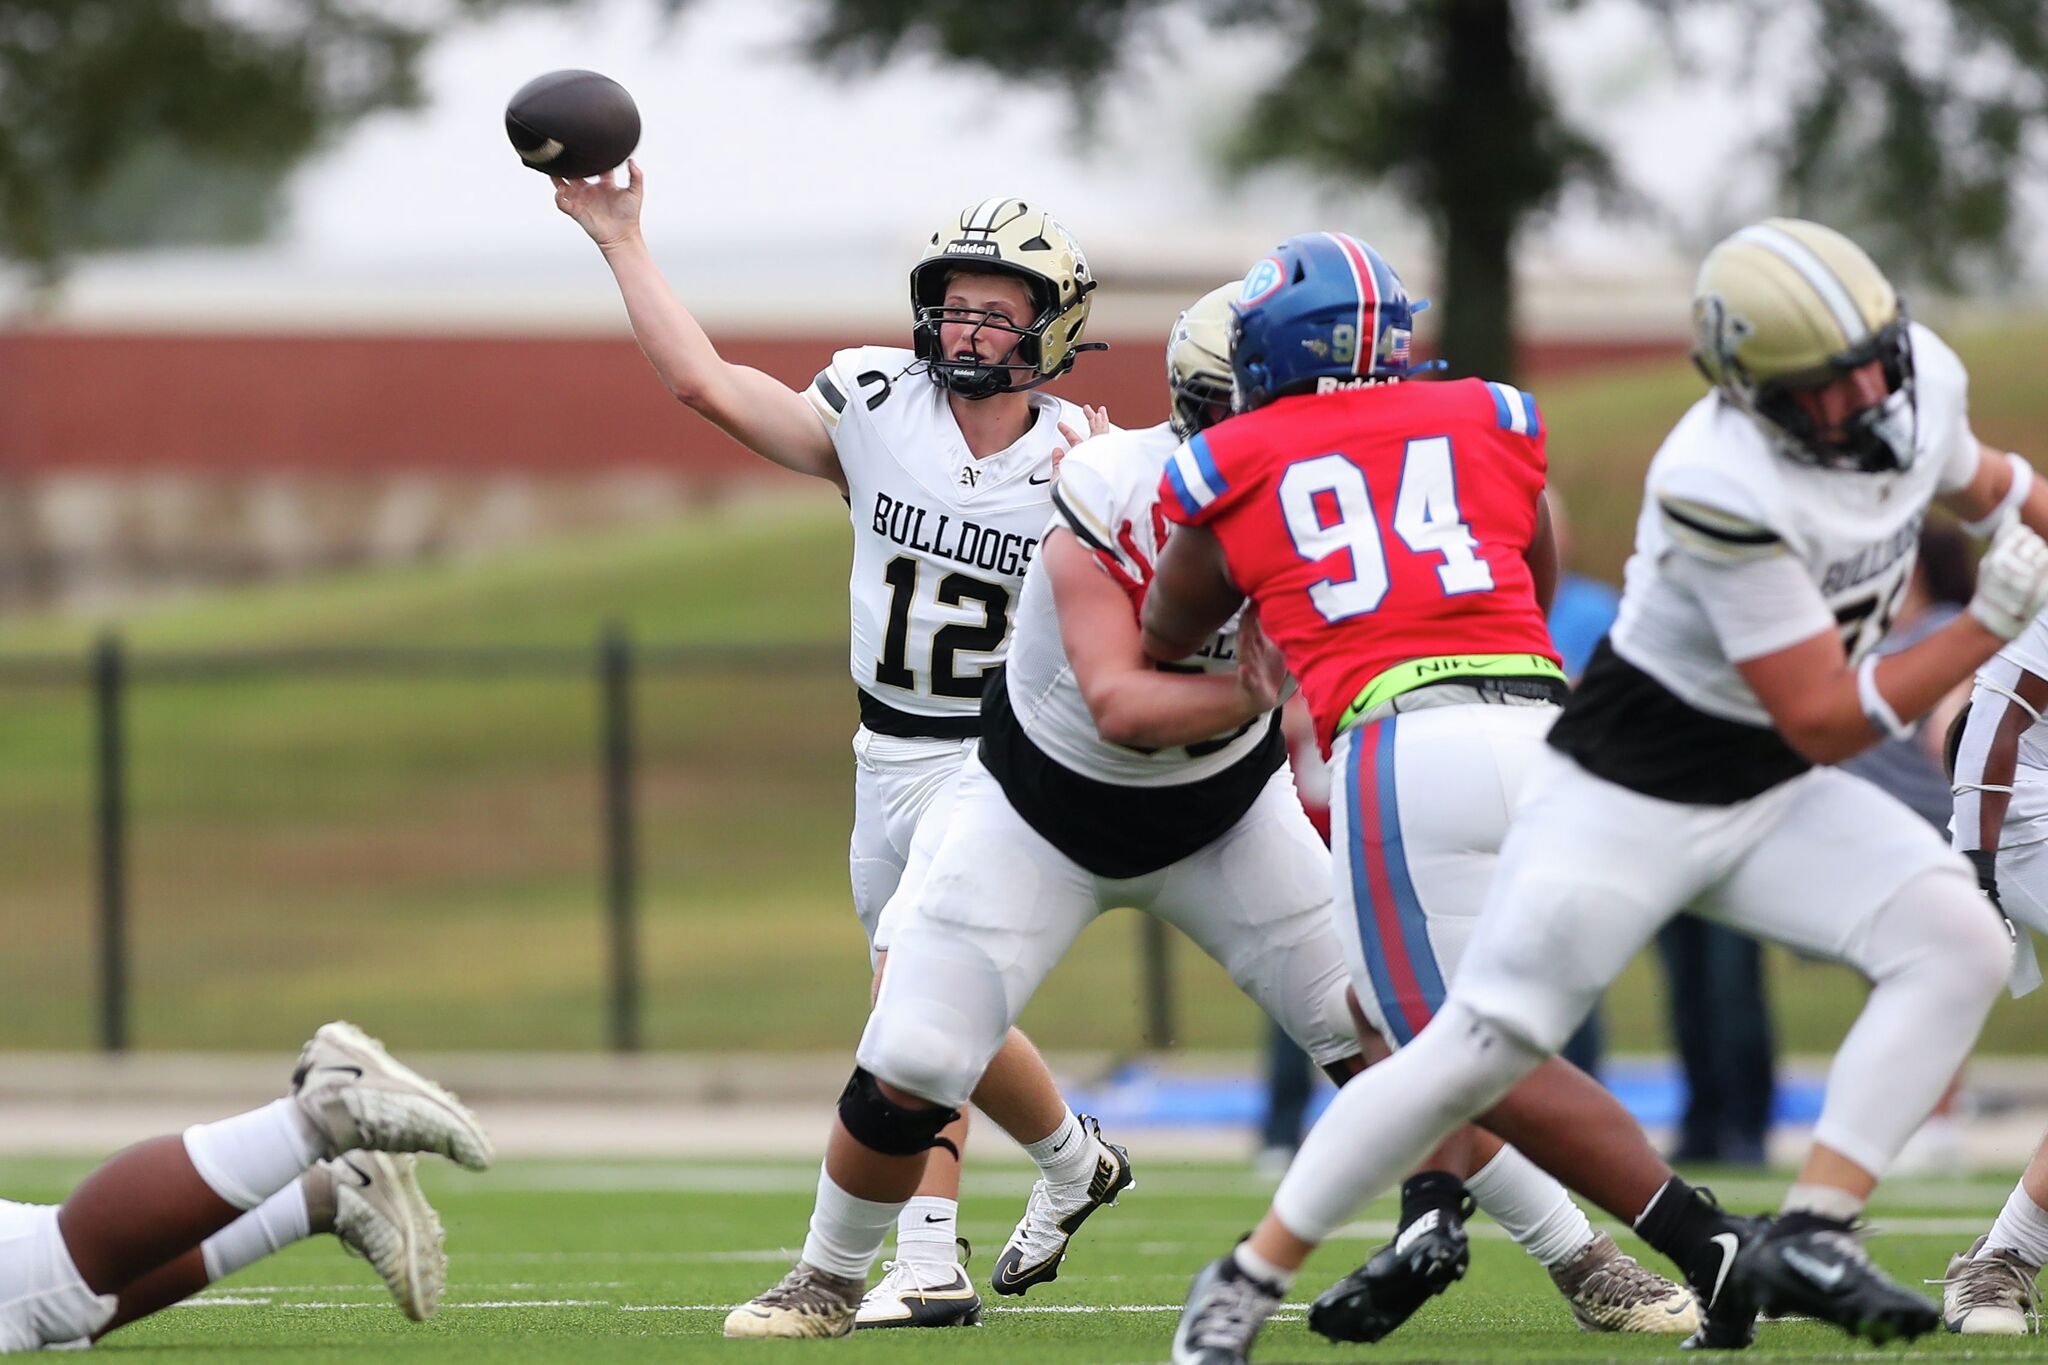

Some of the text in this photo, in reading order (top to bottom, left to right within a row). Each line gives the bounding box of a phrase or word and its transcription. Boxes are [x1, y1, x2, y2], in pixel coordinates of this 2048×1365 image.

[947, 243, 996, 256] Riddell
[959, 466, 982, 488] N
[872, 492, 1040, 577] BULLDOGS
[1277, 435, 1496, 625] 94
[873, 553, 1011, 700] 12
[1087, 1153, 1114, 1202] NIKE
